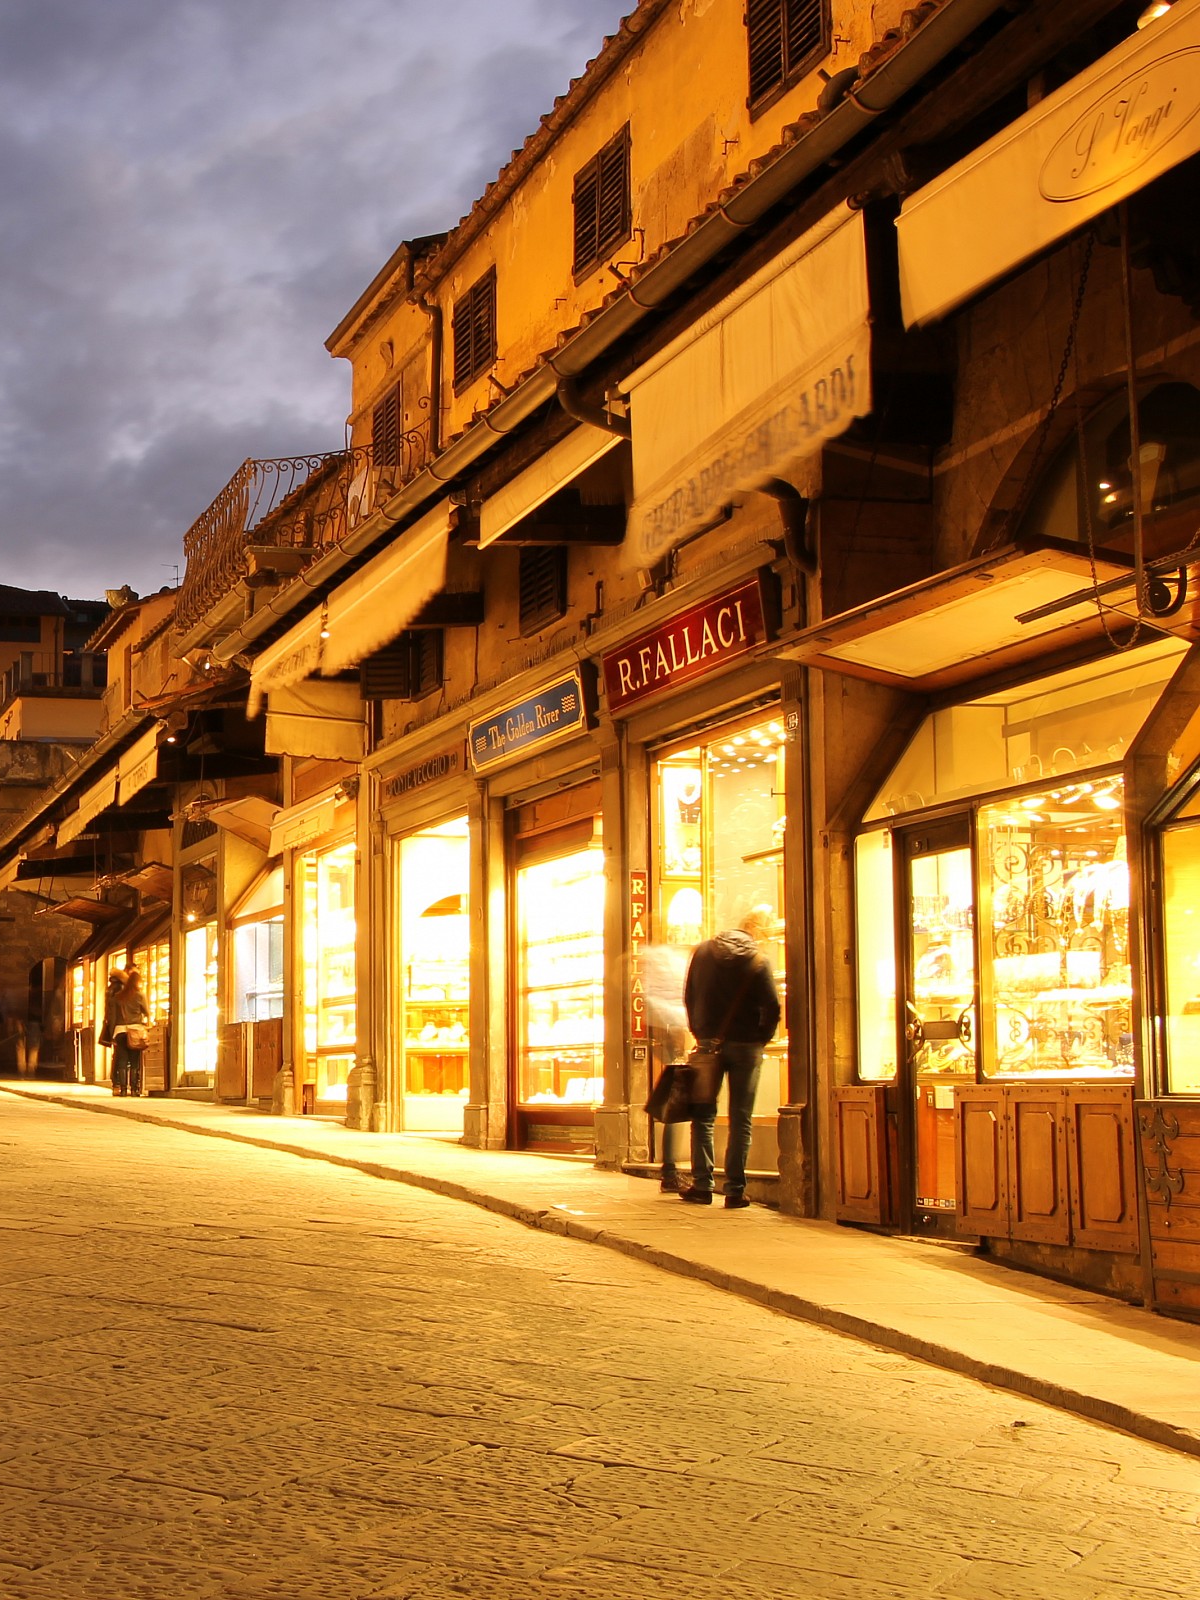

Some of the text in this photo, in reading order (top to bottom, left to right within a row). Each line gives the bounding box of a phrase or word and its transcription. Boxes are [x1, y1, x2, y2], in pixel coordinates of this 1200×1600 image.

[1114, 81, 1178, 159] Vaggi
[488, 704, 560, 750] The Golden River
